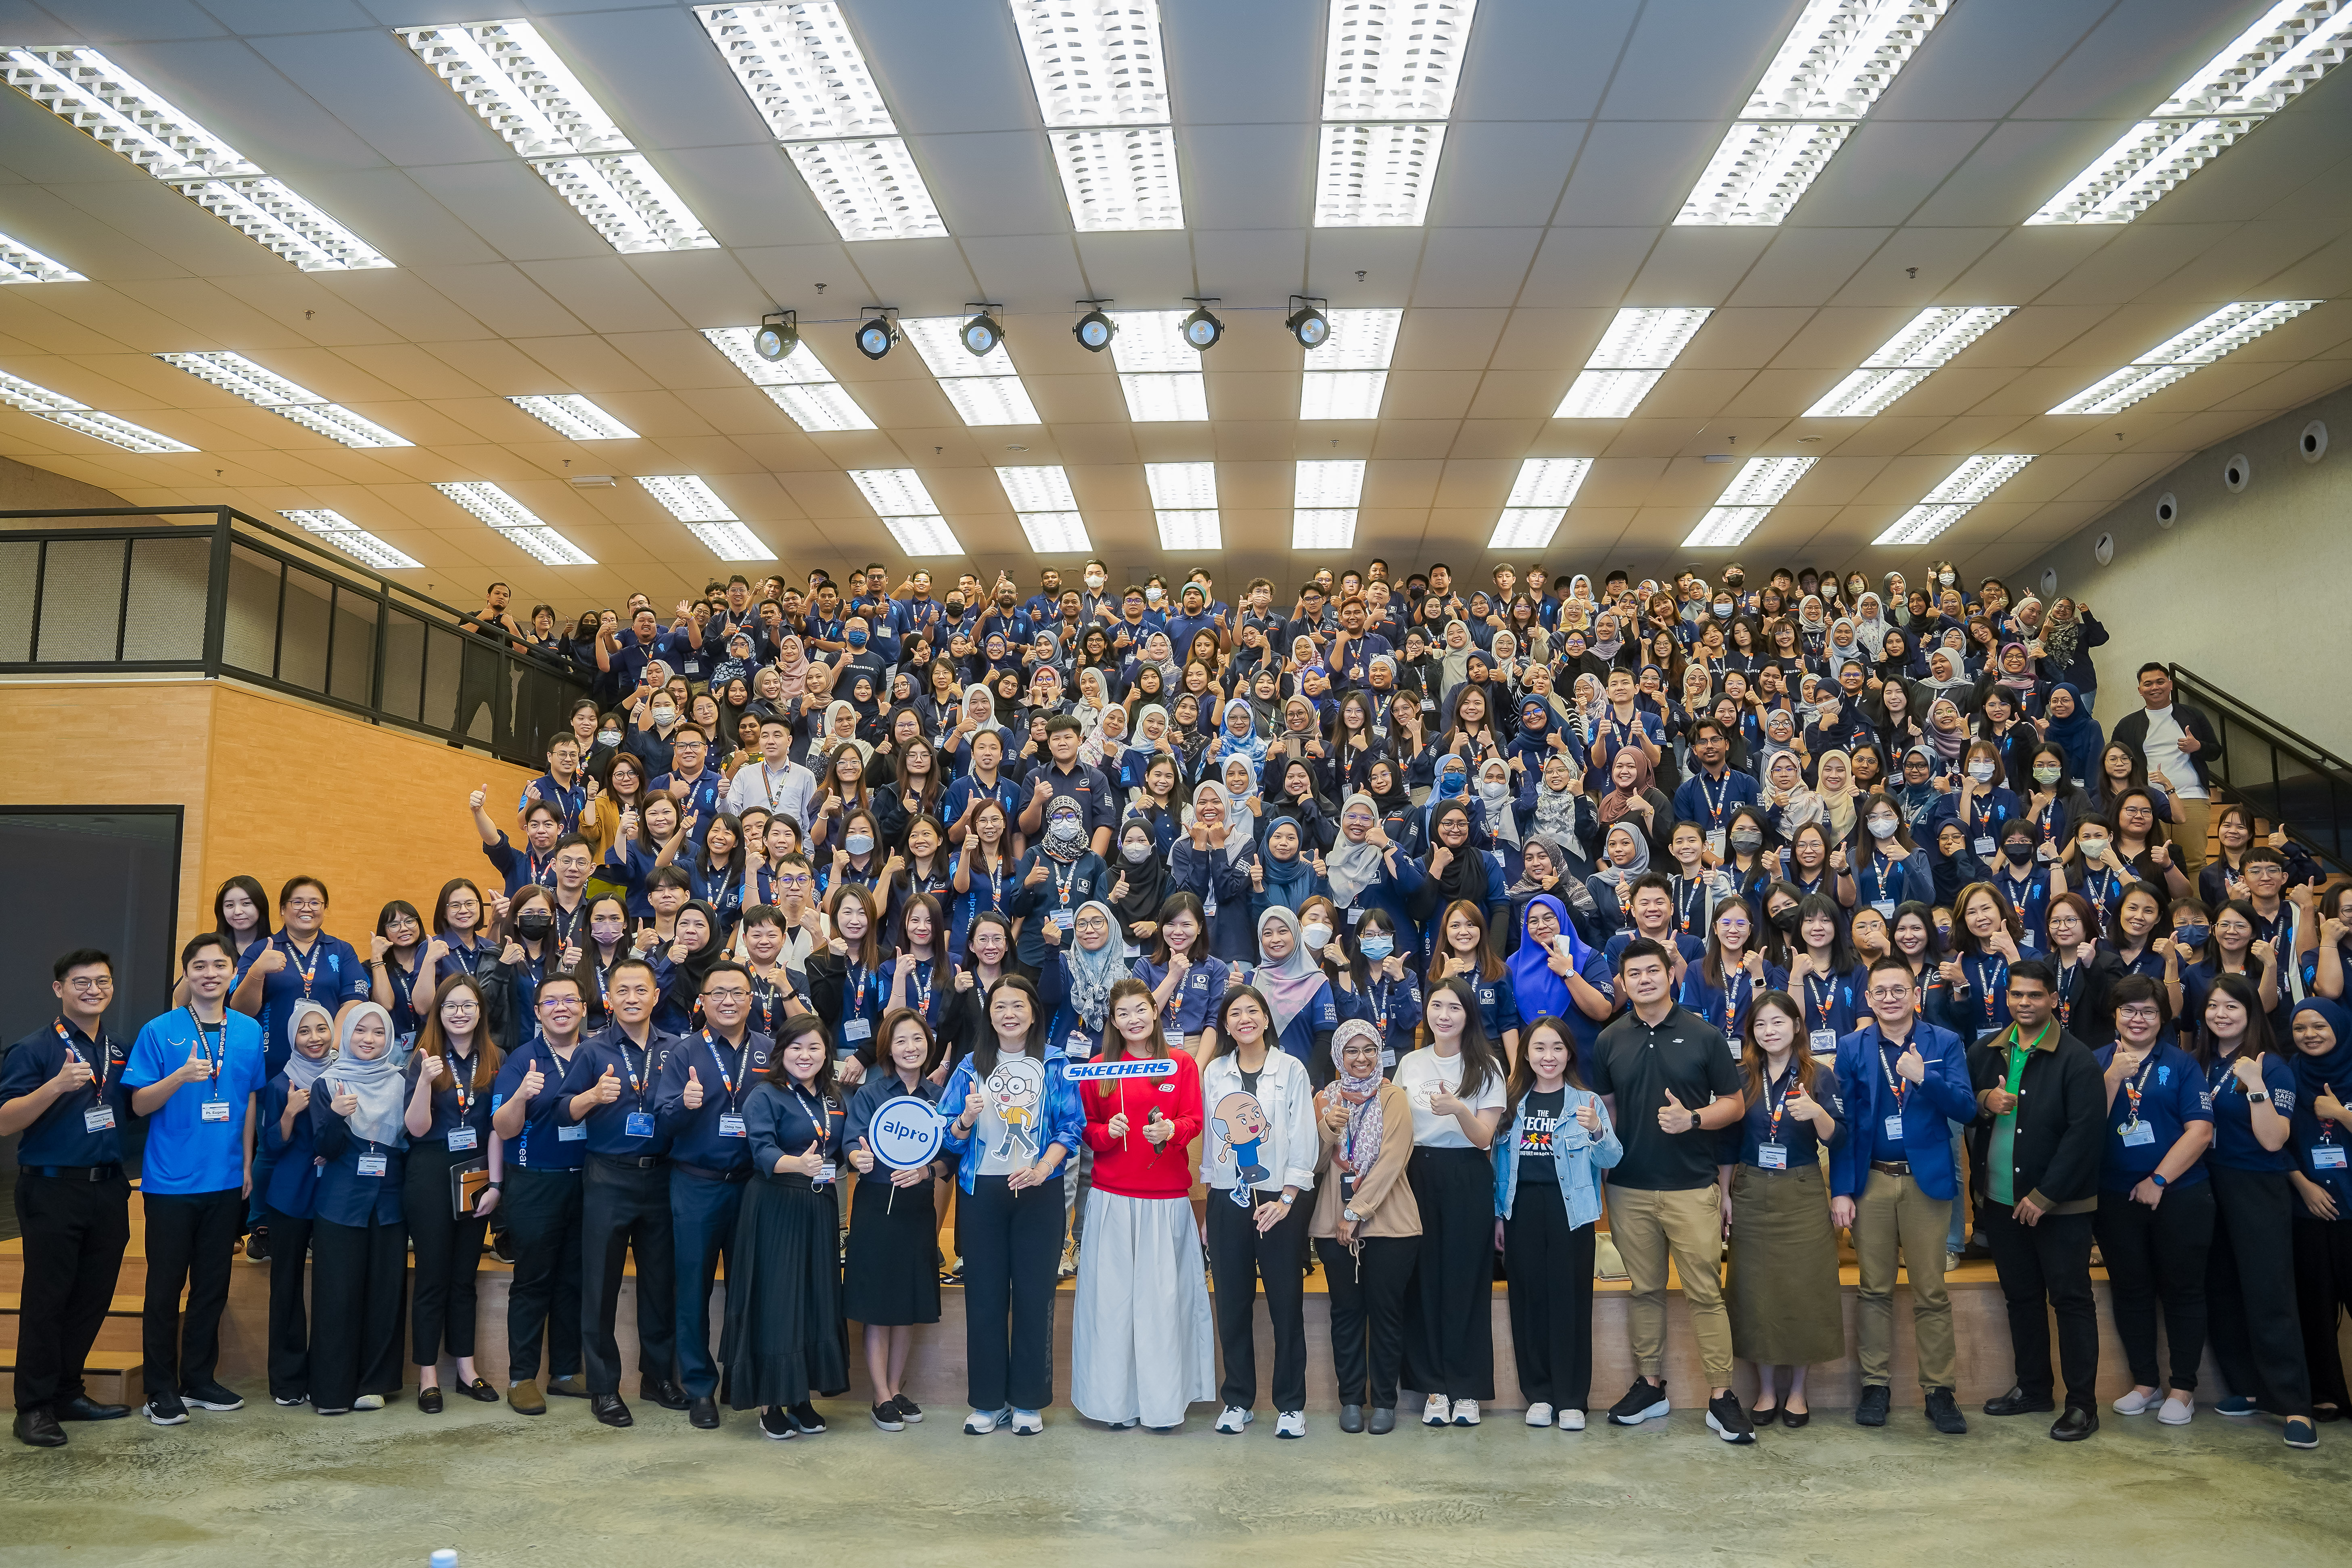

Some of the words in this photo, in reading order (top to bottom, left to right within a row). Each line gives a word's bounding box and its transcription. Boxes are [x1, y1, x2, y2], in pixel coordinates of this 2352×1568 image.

[289, 950, 299, 964] VIBRANT
[296, 963, 304, 973] WORLD
[460, 957, 468, 972] VIBRANT
[1809, 978, 1817, 993] VIBRANT
[193, 1016, 203, 1033] HEALTHY
[202, 1035, 210, 1052] VIBRANT
[545, 1040, 554, 1054] HEALTHY
[554, 1056, 563, 1072] VIBRANT
[1068, 1062, 1171, 1077] SKECHERS
[1881, 1052, 1889, 1069] VIBRANT
[1885, 1069, 1894, 1084] WORLD
[2138, 1077, 2147, 1090] WORLD
[884, 1121, 928, 1142] alpro
